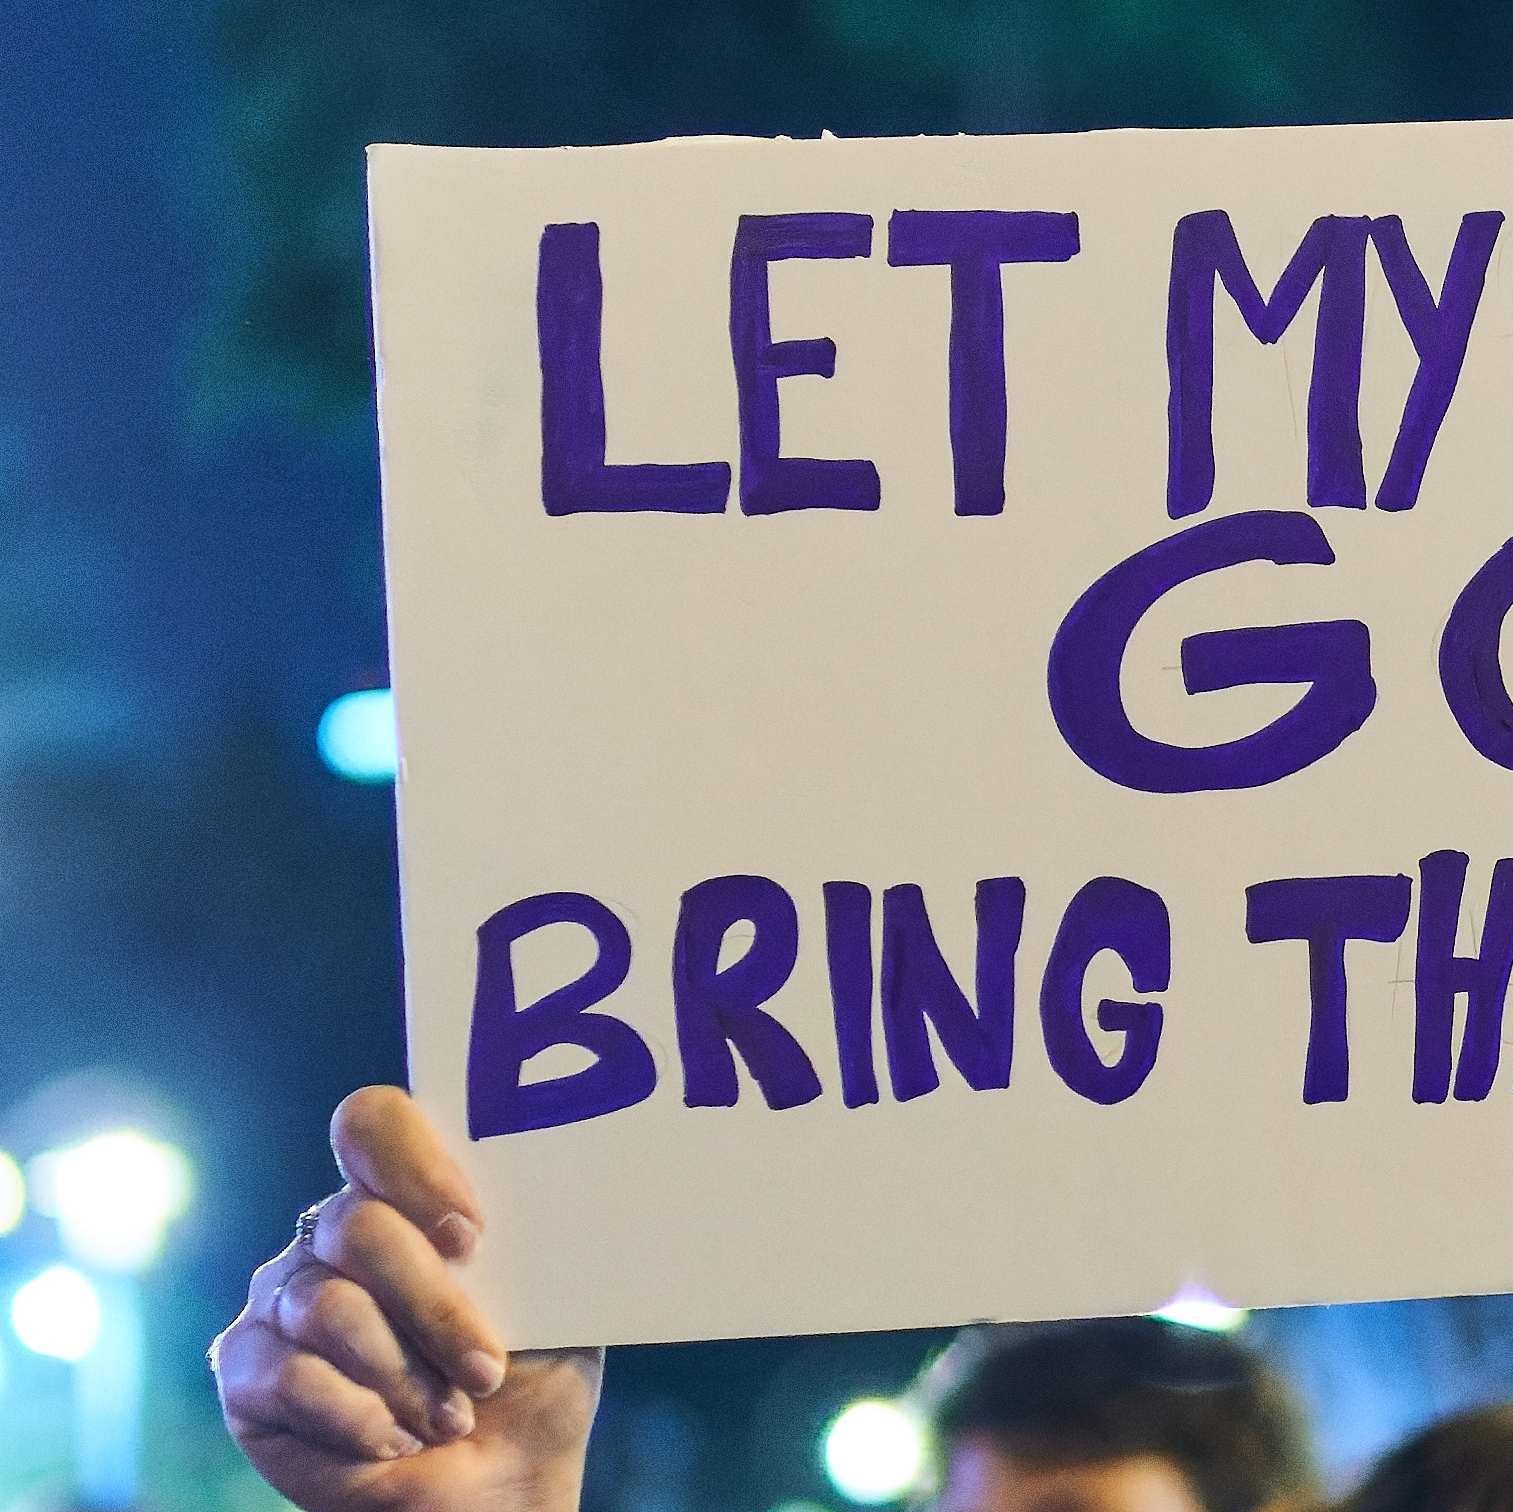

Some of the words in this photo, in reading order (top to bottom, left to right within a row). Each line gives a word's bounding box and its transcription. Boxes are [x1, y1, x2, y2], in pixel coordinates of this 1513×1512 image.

[537, 210, 1081, 517] LET
[1167, 210, 1505, 520] MY
[466, 875, 1171, 1142] BRING
